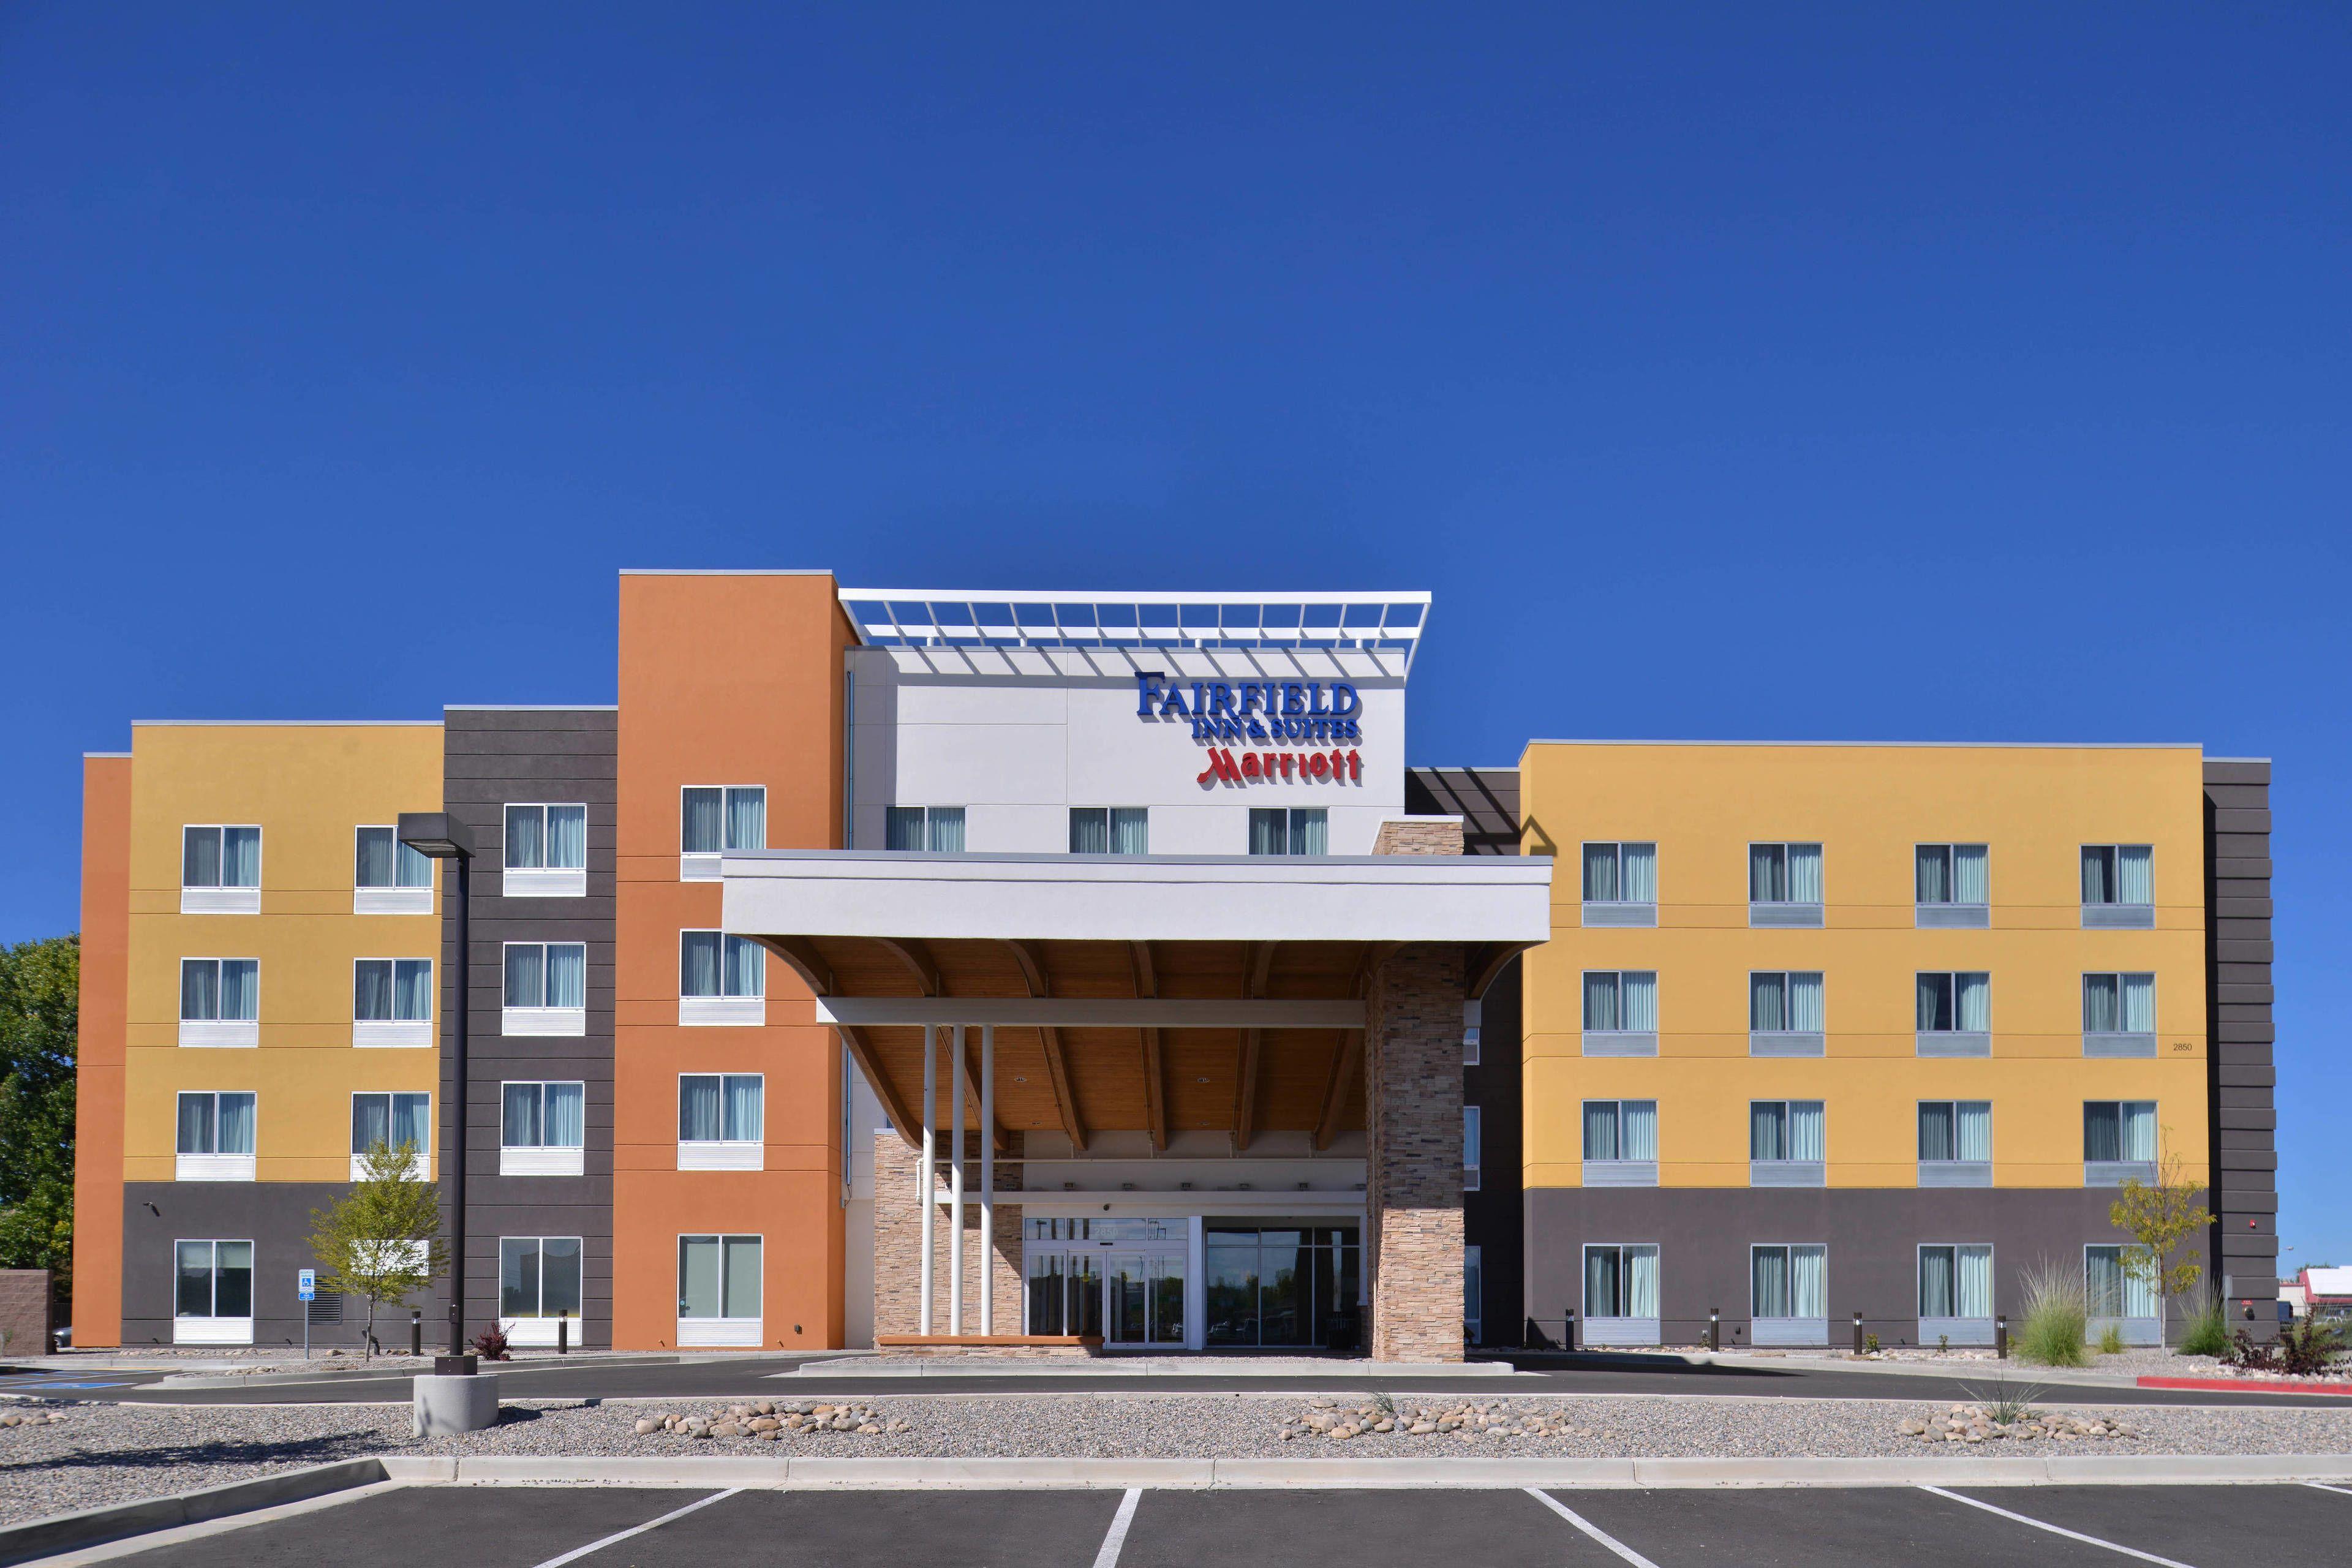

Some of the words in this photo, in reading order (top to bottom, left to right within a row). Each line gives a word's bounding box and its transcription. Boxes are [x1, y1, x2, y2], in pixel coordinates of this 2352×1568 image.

[1134, 671, 1359, 719] FAIRFIELD
[1191, 718, 1243, 739] INN
[1246, 718, 1267, 739] &
[1270, 718, 1358, 739] SUITES
[1197, 747, 1358, 783] Marriott
